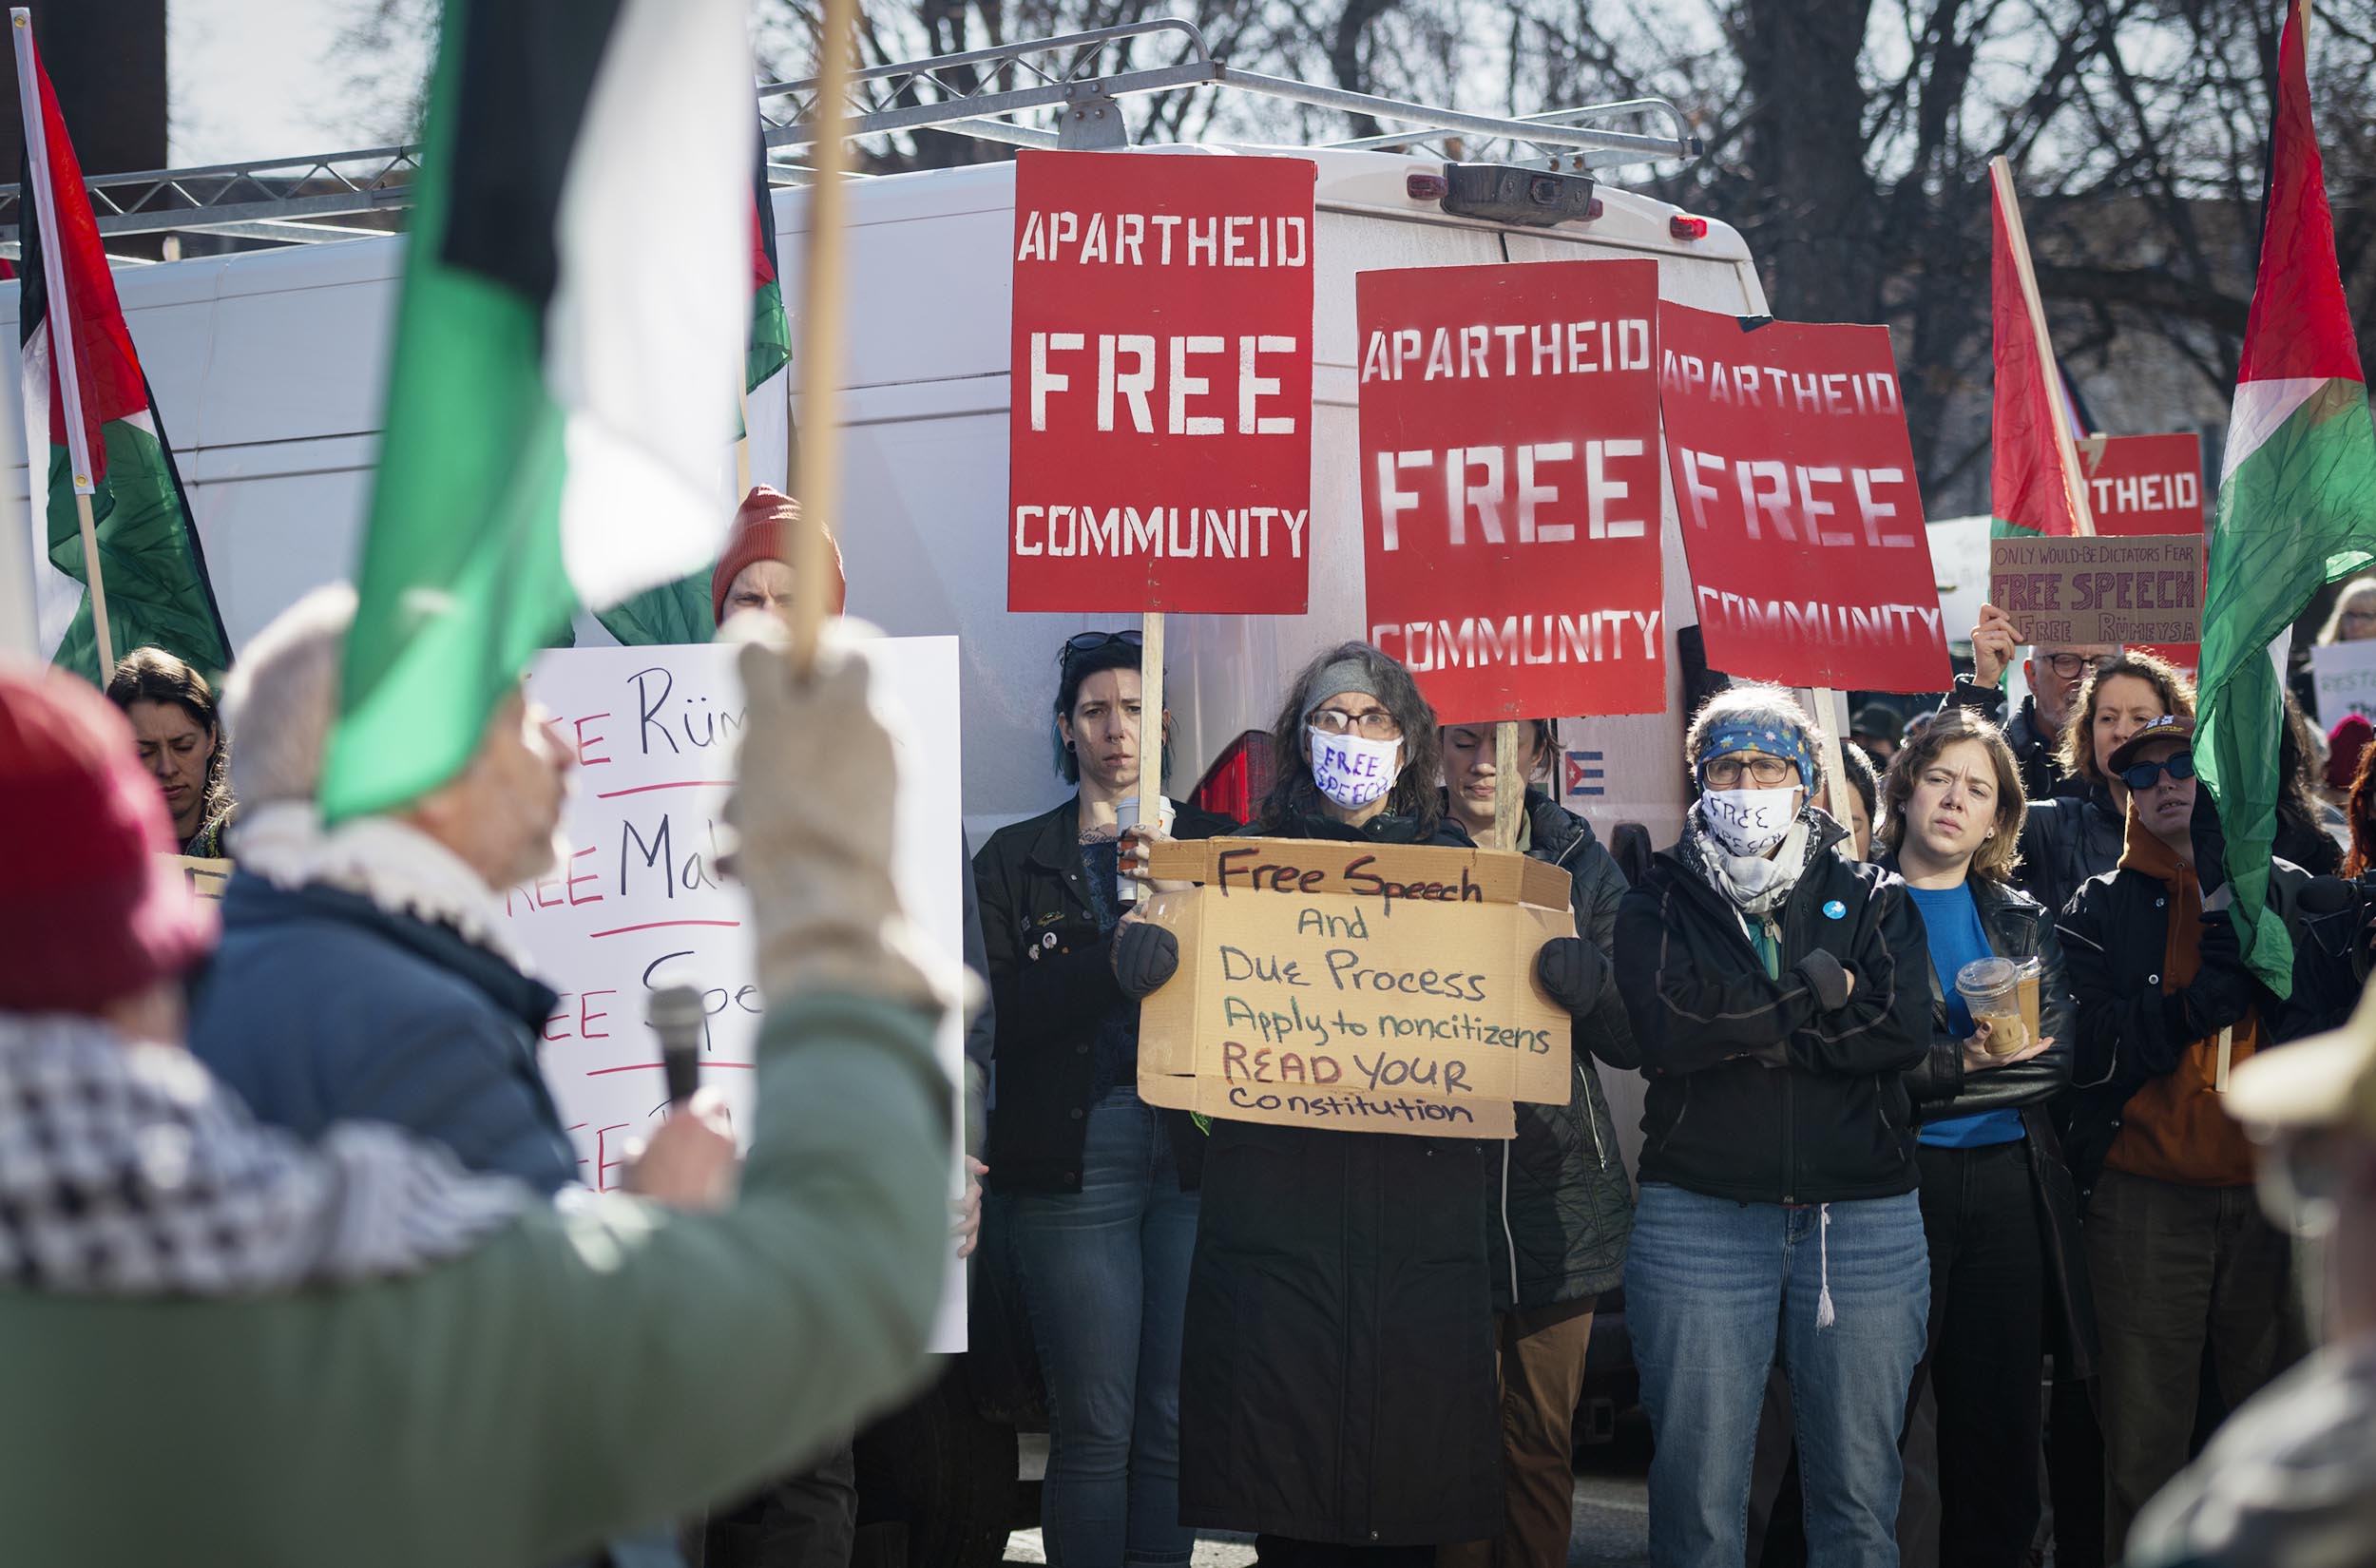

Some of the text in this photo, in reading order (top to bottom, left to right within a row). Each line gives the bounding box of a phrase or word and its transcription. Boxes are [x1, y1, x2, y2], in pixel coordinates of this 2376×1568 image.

[1018, 211, 1306, 267] APARTHEID
[1361, 318, 1650, 383] APARTHEID
[1031, 332, 1296, 435] FREE
[1663, 349, 1900, 415] APARTHEID
[1377, 439, 1644, 550] FREE
[1680, 447, 1915, 547] FREE
[1016, 505, 1308, 559] COMMUNITY
[1996, 544, 2194, 566] ONLY WOULD-BE DICTATORS FEAR
[1696, 584, 1940, 650] COMMUNITY
[1991, 571, 2195, 611] FREE SPEECH
[1371, 609, 1660, 672] COMMUNITY
[2019, 613, 2195, 641] FREE RÜMEYSA
[1325, 746, 1381, 777] FREE
[1711, 797, 1769, 829] FREE
[1718, 829, 1782, 854] PEECH
[1217, 847, 1483, 918] Free Speech
[1297, 906, 1370, 940] And
[1324, 948, 1486, 1002] Process
[1224, 995, 1552, 1055] Apply to noncitizens
[1222, 1041, 1343, 1085] READ
